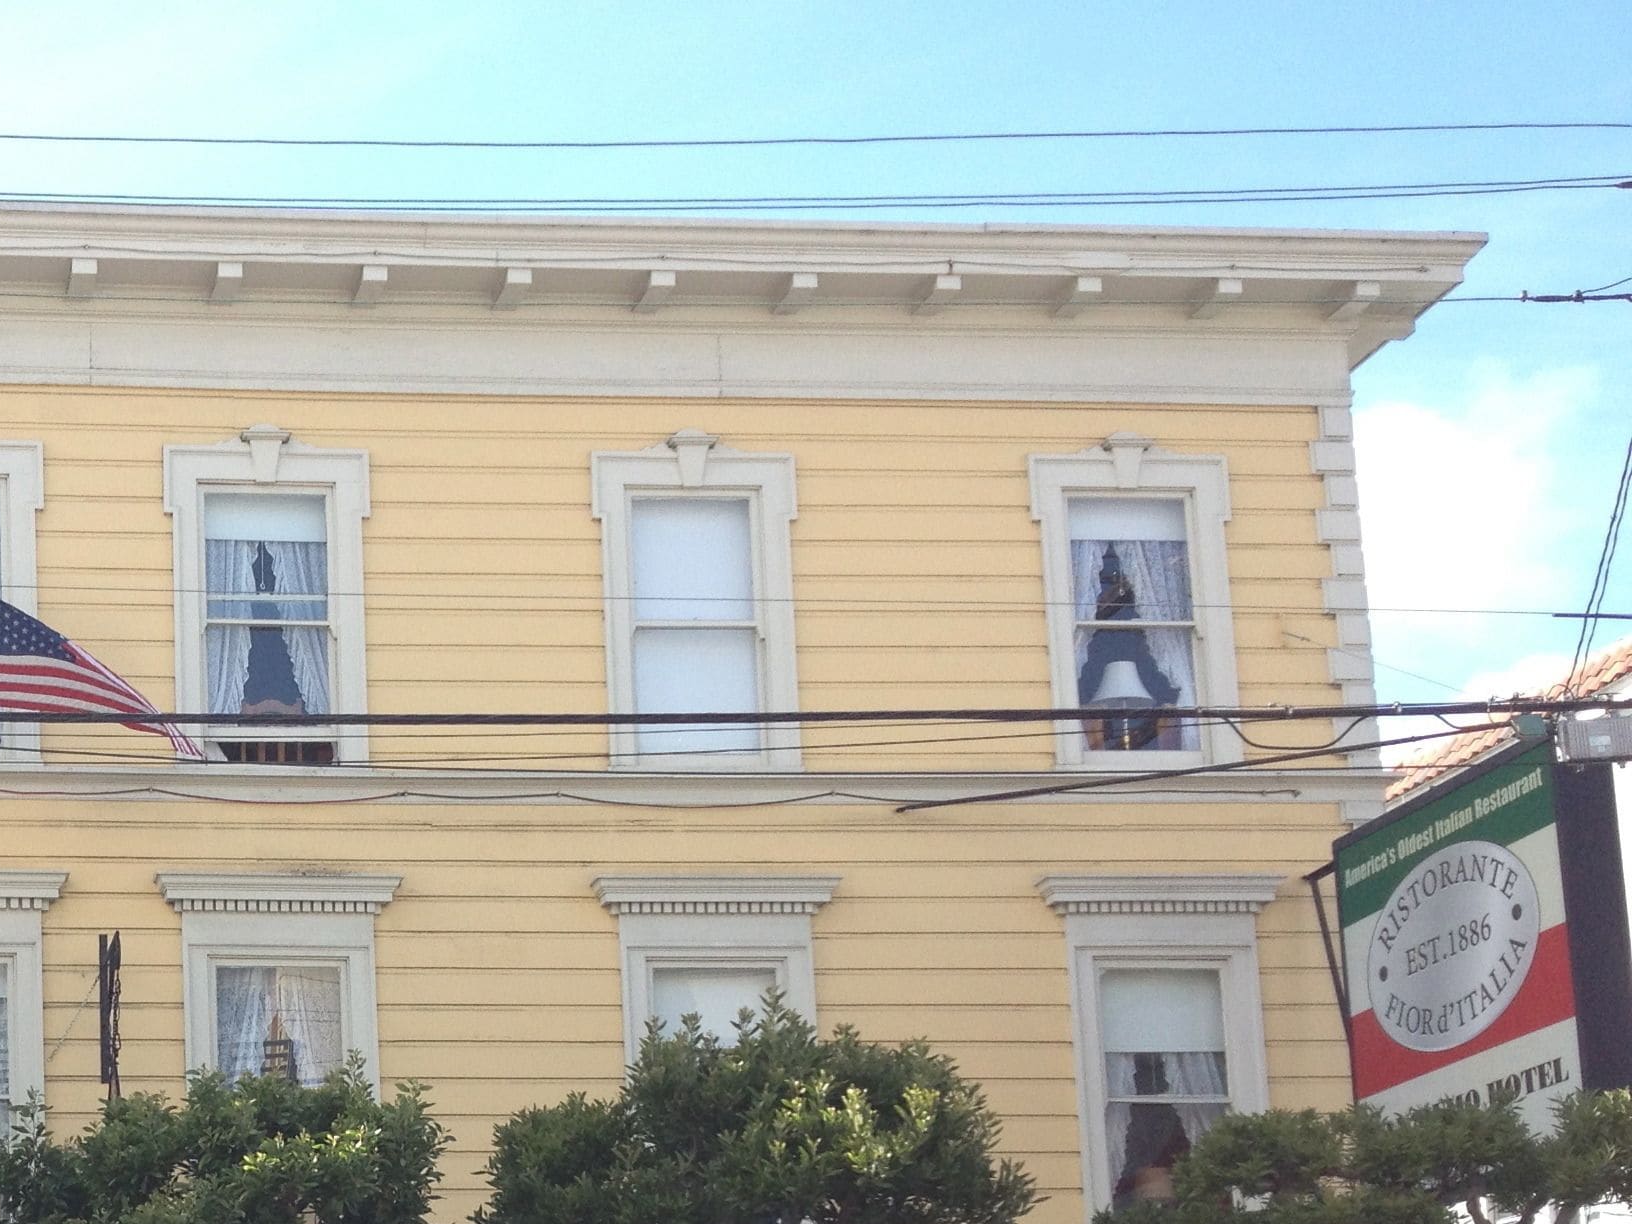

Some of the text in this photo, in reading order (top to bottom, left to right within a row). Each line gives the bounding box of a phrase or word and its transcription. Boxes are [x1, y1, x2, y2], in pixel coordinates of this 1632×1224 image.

[1344, 766, 1544, 889] America's Oldest Italian Restaurant
[1377, 853, 1519, 953] RISTORANTE
[1385, 992, 1435, 1036] FIOR
